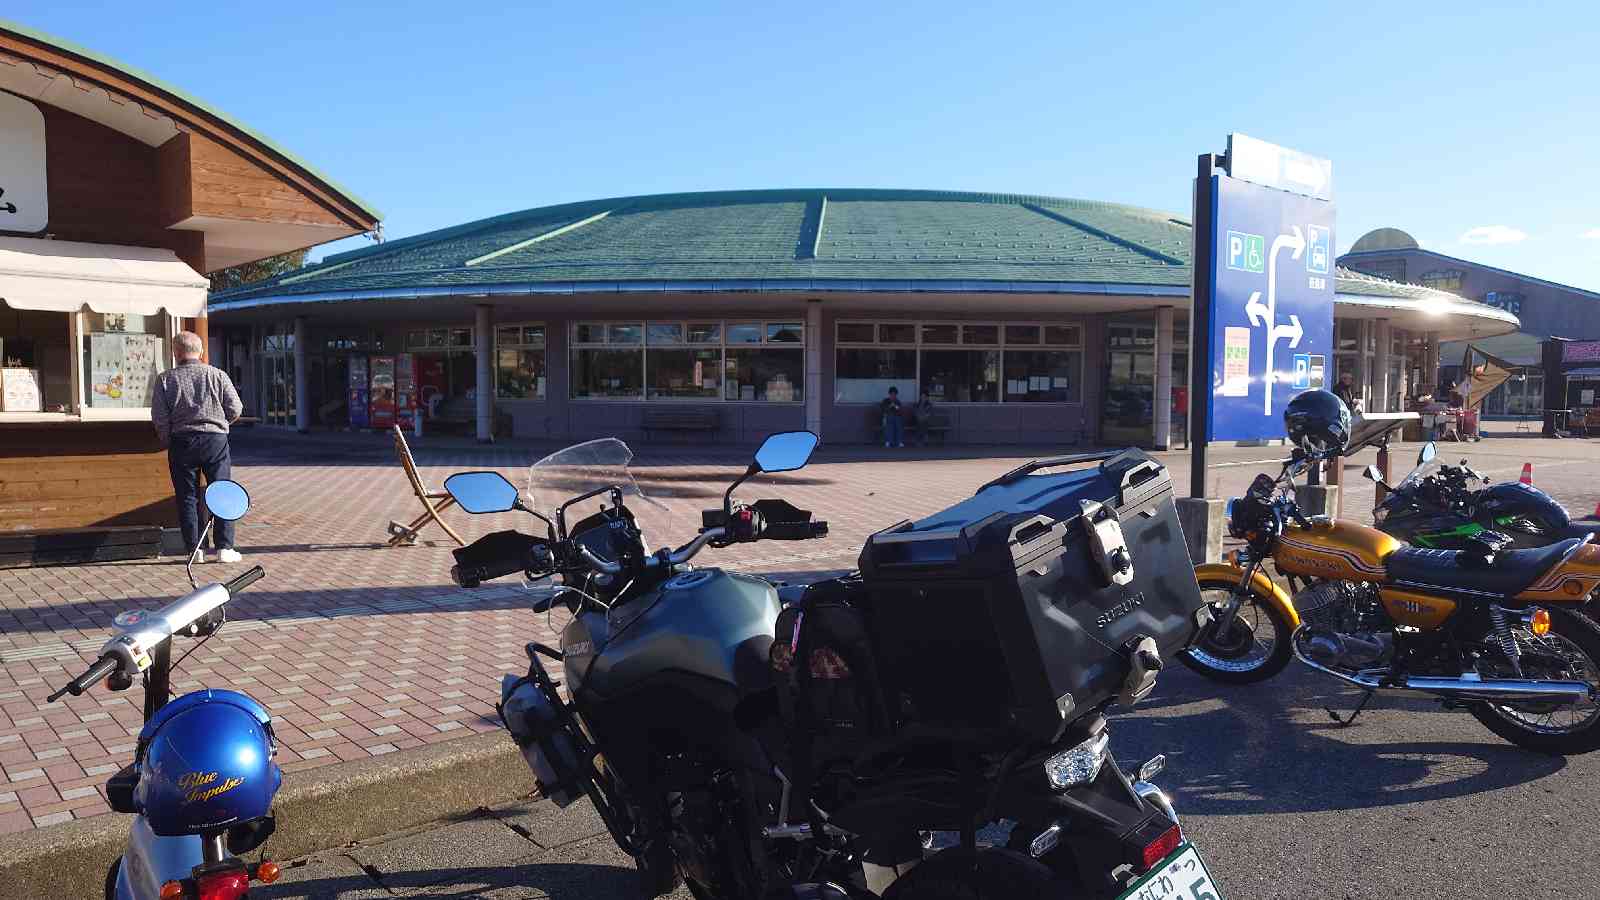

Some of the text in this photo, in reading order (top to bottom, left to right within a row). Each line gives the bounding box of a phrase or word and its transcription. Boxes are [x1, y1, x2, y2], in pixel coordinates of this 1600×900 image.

[1230, 236, 1242, 266] P
[1296, 359, 1307, 386] P
[1097, 591, 1145, 628] SUZUKI
[178, 771, 218, 790] Blue
[185, 775, 246, 801] Impulse
